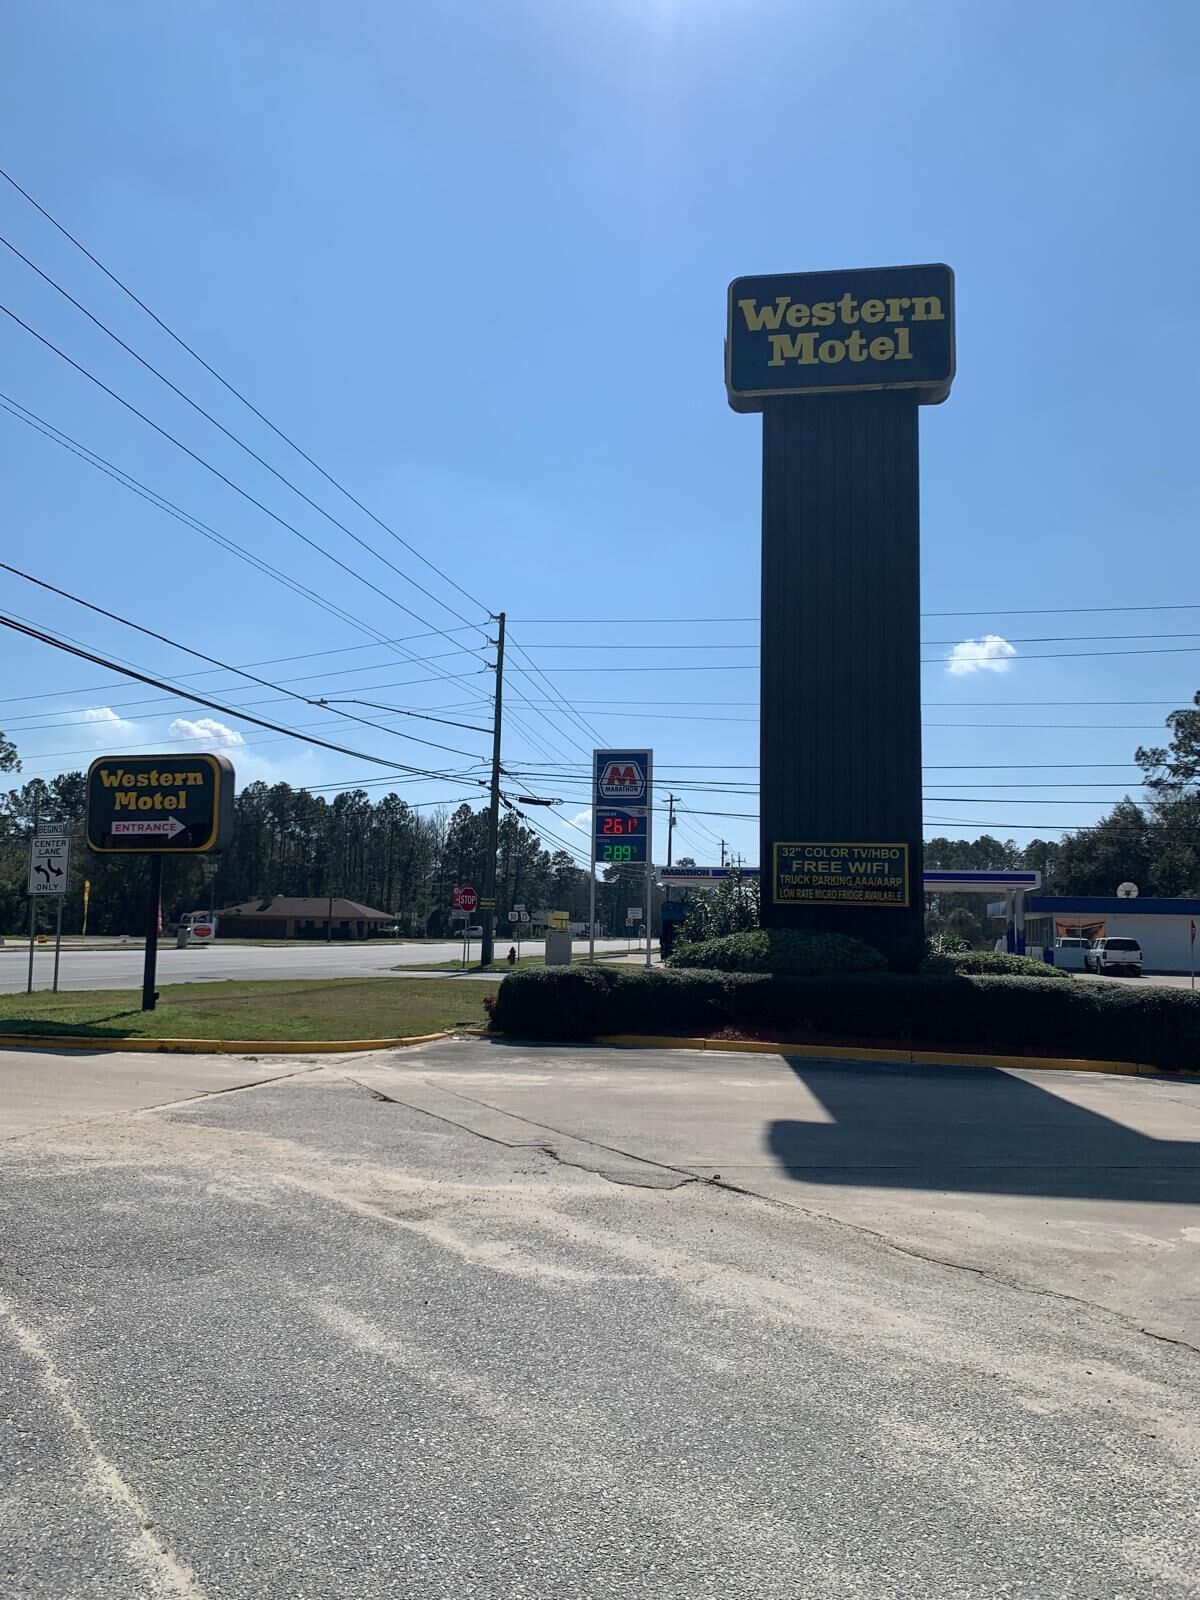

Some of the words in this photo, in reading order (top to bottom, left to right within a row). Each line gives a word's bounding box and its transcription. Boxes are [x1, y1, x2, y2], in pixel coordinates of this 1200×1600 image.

[738, 292, 945, 331] Western
[767, 328, 913, 367] Motel
[99, 769, 204, 788] Western
[605, 785, 638, 793] MARATHON
[114, 790, 187, 811] Motel
[38, 825, 63, 834] BEGINS
[115, 823, 177, 833] ENTRANCE
[34, 840, 67, 848] CENTER
[782, 847, 801, 857] 32"
[804, 847, 849, 858] COLOR
[852, 848, 900, 859] TV/HBO
[661, 869, 709, 877] MARATHON
[792, 860, 842, 872] FREE
[848, 861, 889, 874] WIFI
[780, 874, 811, 885] TRUCK
[812, 875, 853, 886] PARKING
[854, 876, 902, 887] AAA/AARP
[36, 883, 59, 891] ONLY
[460, 895, 476, 905] STOP
[780, 888, 795, 898] LOW
[796, 889, 814, 898] RATE
[815, 889, 837, 899] MICRO
[838, 889, 864, 900] FRIDGE
[864, 890, 902, 901] AVAILABLE
